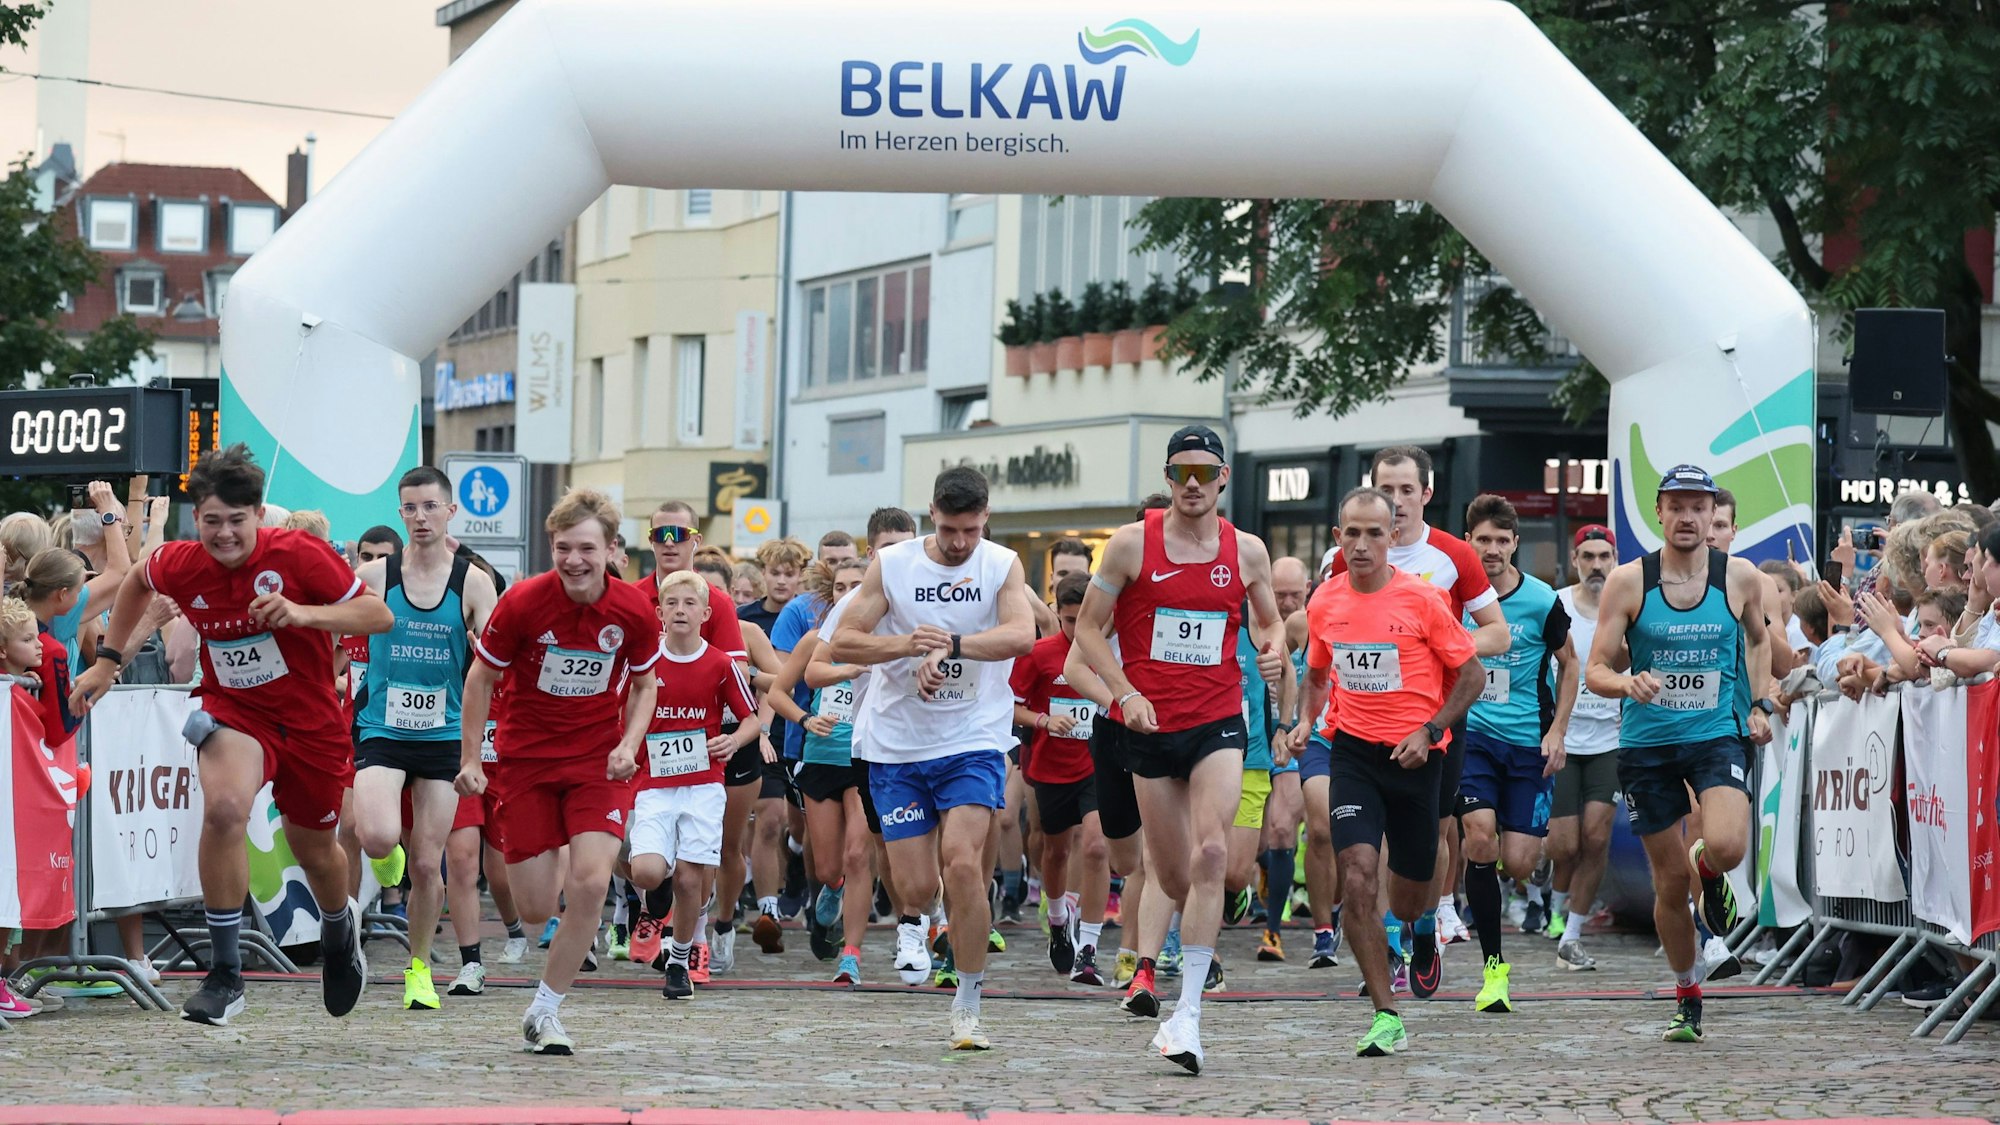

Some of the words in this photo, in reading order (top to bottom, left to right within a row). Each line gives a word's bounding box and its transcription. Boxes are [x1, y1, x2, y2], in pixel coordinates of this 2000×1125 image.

[840, 60, 1127, 121] BELKAW
[840, 130, 866, 149] Im
[875, 131, 957, 151] Herzen
[966, 132, 1070, 157] bergisch.
[527, 330, 552, 414] WILMS
[11, 407, 126, 454] 0:00:02
[1268, 467, 1310, 501] KIND
[464, 520, 503, 535] ZONE
[407, 621, 452, 633] REFRATH
[1178, 621, 1202, 641] 91
[1668, 623, 1722, 634] REFRATH
[406, 630, 432, 640] running
[222, 646, 262, 667] 324
[390, 645, 450, 660] ENGELS
[1164, 650, 1211, 664] BELKAW
[1652, 648, 1718, 662] ENGELS
[561, 659, 603, 677] 329
[1346, 652, 1381, 670] 147
[229, 671, 274, 688] BELKAW
[1347, 681, 1388, 691] BELKAW
[1664, 674, 1704, 690] 306
[550, 684, 597, 695] BELKAW
[402, 692, 436, 710] 308
[1661, 698, 1705, 709] BELKAW
[656, 706, 707, 720] BELKAW
[396, 718, 434, 729] BELKAW
[660, 737, 693, 757] 210
[660, 763, 698, 776] BELKAW
